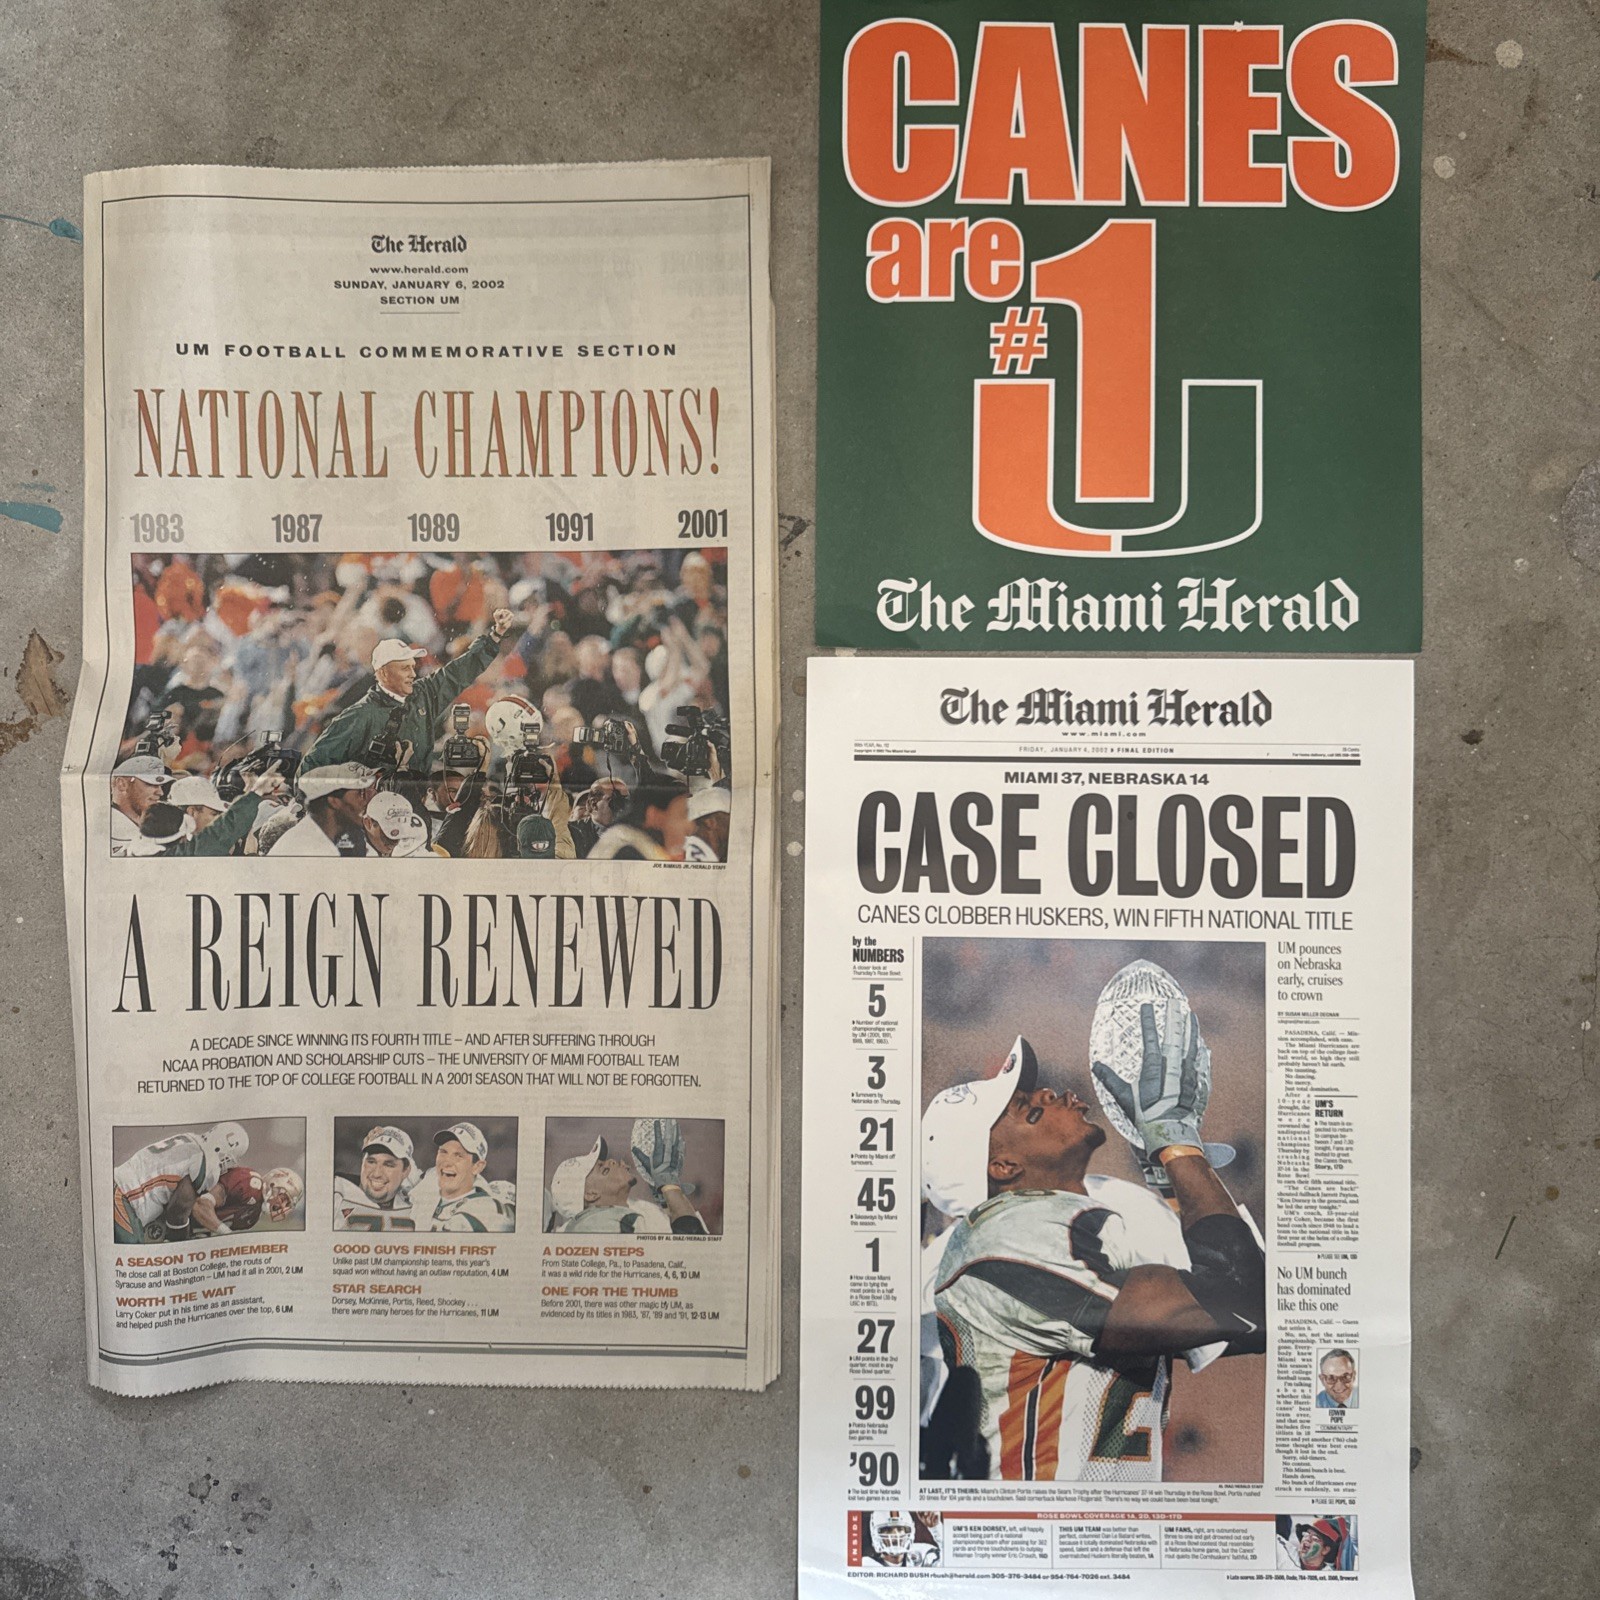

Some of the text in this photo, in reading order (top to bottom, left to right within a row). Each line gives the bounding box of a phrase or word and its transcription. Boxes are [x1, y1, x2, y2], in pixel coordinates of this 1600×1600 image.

[842, 18, 1400, 212] CANES
[372, 234, 467, 253] The Herald
[370, 265, 468, 274] www.herald.com
[866, 217, 1024, 303] are
[334, 280, 504, 290] SUNDAY, JANUARY 6, 2002
[380, 296, 459, 304] SECTION UM
[176, 344, 675, 358] UM FOOTBALL COMMEMORATIVE SECTION
[133, 386, 719, 479] NATIONAL CHAMPIONS!
[130, 509, 727, 543] 1983 1987 1989 1991 2001
[877, 578, 1358, 632] The Miami Herald
[941, 688, 1272, 726] The Miami Herald
[1005, 772, 1209, 786] MIAMI 37, NEBRASKA 14
[857, 791, 1356, 899] CASE CLOSED
[858, 904, 1353, 930] CANES CLOBBER HUSKERS, WIN FIFTH NATIONAL TITLE
[852, 936, 876, 948] by the
[1278, 942, 1342, 956] UM pounces
[112, 892, 722, 1012] A REIGN RENEWED
[853, 948, 904, 962] NUMBERS
[1278, 957, 1342, 970] on Nebraska
[1278, 973, 1343, 988] early, cruises
[868, 984, 886, 1017] 5
[1278, 990, 1322, 1001] to crown
[190, 1033, 655, 1051] A DECADE SINCE WINNING ITS FOURTH TITLE AND AFTER SUFFERING THROUGH
[163, 1053, 679, 1072] NCAA PROBATION AND SCHOLARSHIP CUTS THE UNIVERSITY OF MIAMI FOOTBALL TEAM
[138, 1072, 701, 1093] RETURNED TO THE TOP OF COLLEGE FOOTBALL IN A 2001 SEASON THAT WILL NOT BE FORGOTTEN.
[868, 1056, 886, 1090] 3
[1315, 1100, 1333, 1108] UM'S
[860, 1117, 893, 1151] 21
[858, 1178, 895, 1212] 45
[116, 1244, 288, 1266] A SEASON TO REMEMBER
[334, 1244, 496, 1255] GOOD GUYS FINISH FIRST
[543, 1247, 644, 1256] A DOZEN STEPS
[866, 1238, 879, 1272] 1
[333, 1257, 352, 1265] Unlike
[354, 1258, 368, 1266] past
[384, 1258, 430, 1267] championship
[456, 1258, 468, 1266] this
[470, 1258, 490, 1267] year's
[1278, 1266, 1347, 1279] No UM bunch
[116, 1286, 236, 1307] WORTH THE WAIT
[333, 1284, 422, 1294] STAR SEARCH
[542, 1286, 678, 1297] ONE FOR THE THUMB
[1277, 1282, 1350, 1295] has dominated
[1278, 1298, 1338, 1311] like this one
[857, 1319, 895, 1354] 27
[856, 1385, 895, 1420] 99
[850, 1452, 899, 1486] '90
